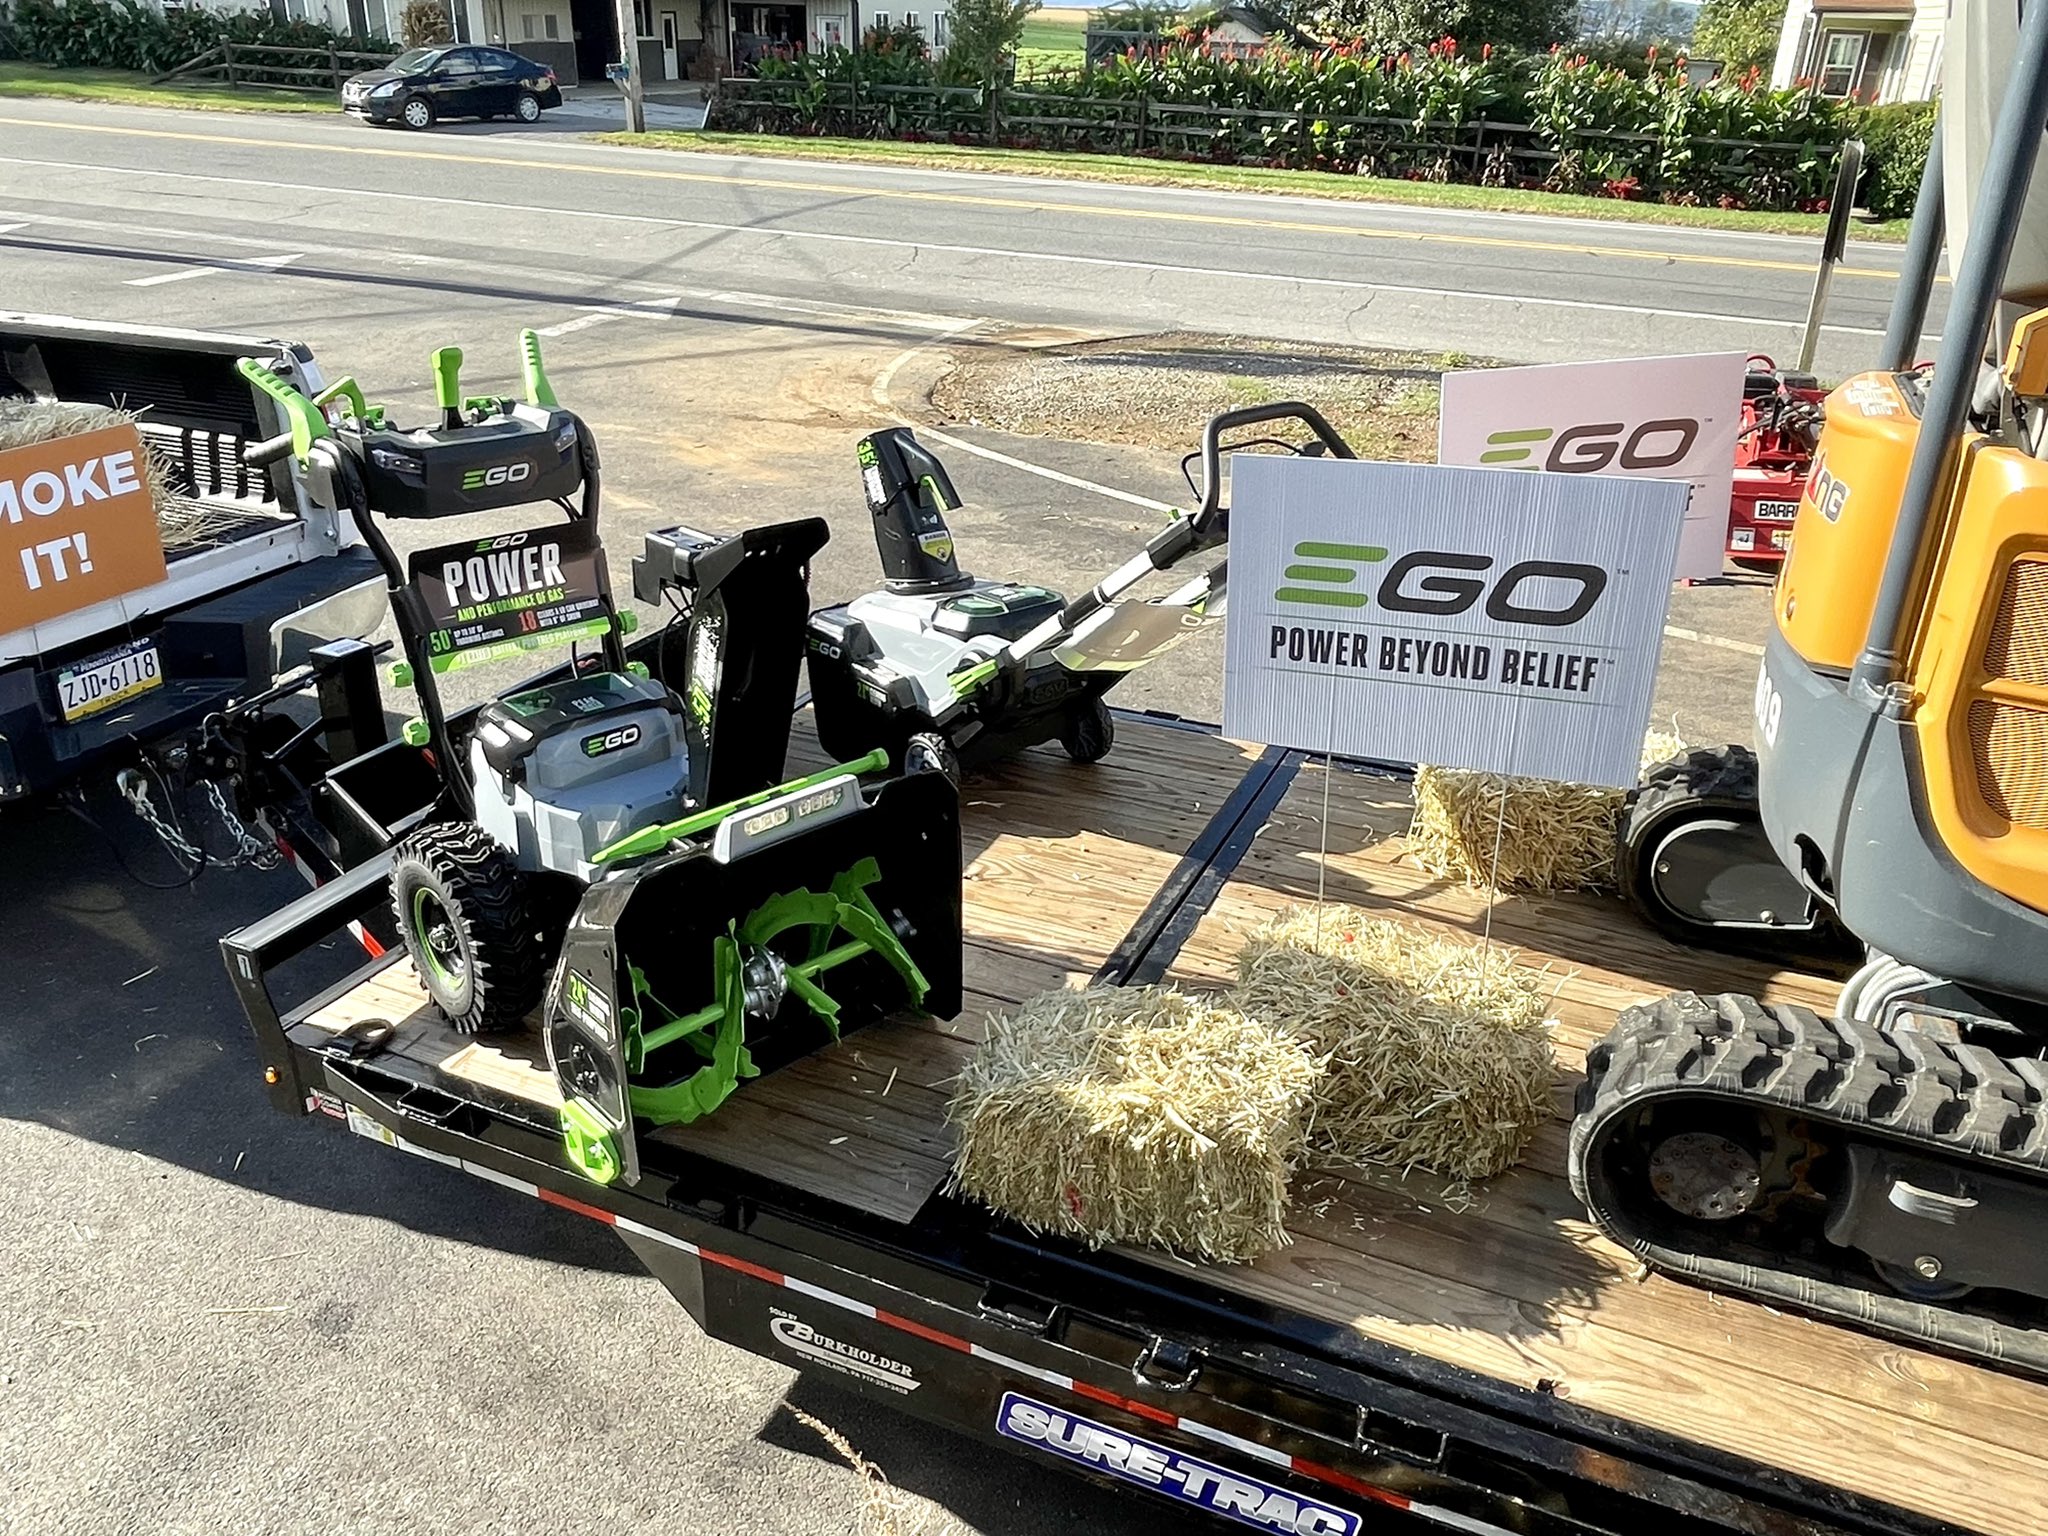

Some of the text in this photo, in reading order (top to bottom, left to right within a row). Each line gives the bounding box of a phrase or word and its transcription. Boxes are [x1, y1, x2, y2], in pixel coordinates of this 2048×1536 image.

[1479, 418, 1699, 473] EGO
[462, 463, 530, 490] EGO
[1758, 503, 1799, 518] BARR
[475, 533, 528, 552] EGO
[20, 532, 94, 590] IT!
[443, 543, 566, 608] POWER
[1274, 541, 1608, 627] EGO
[457, 606, 476, 622] AND
[476, 594, 536, 618] PERFORMANCE
[536, 592, 547, 605] OF
[546, 588, 564, 602] GAS
[518, 610, 537, 632] 18
[429, 628, 452, 653] 50'
[809, 638, 841, 659] EGO
[1270, 625, 1368, 668] POWER
[1379, 636, 1491, 681] BEYOND
[1501, 649, 1598, 692] BELIEF
[588, 727, 638, 755] EGO
[769, 1306, 798, 1321] SOLD BY
[785, 1320, 913, 1377] BURKHOLDER
[1006, 1402, 1347, 1536] SURE-TRAC
